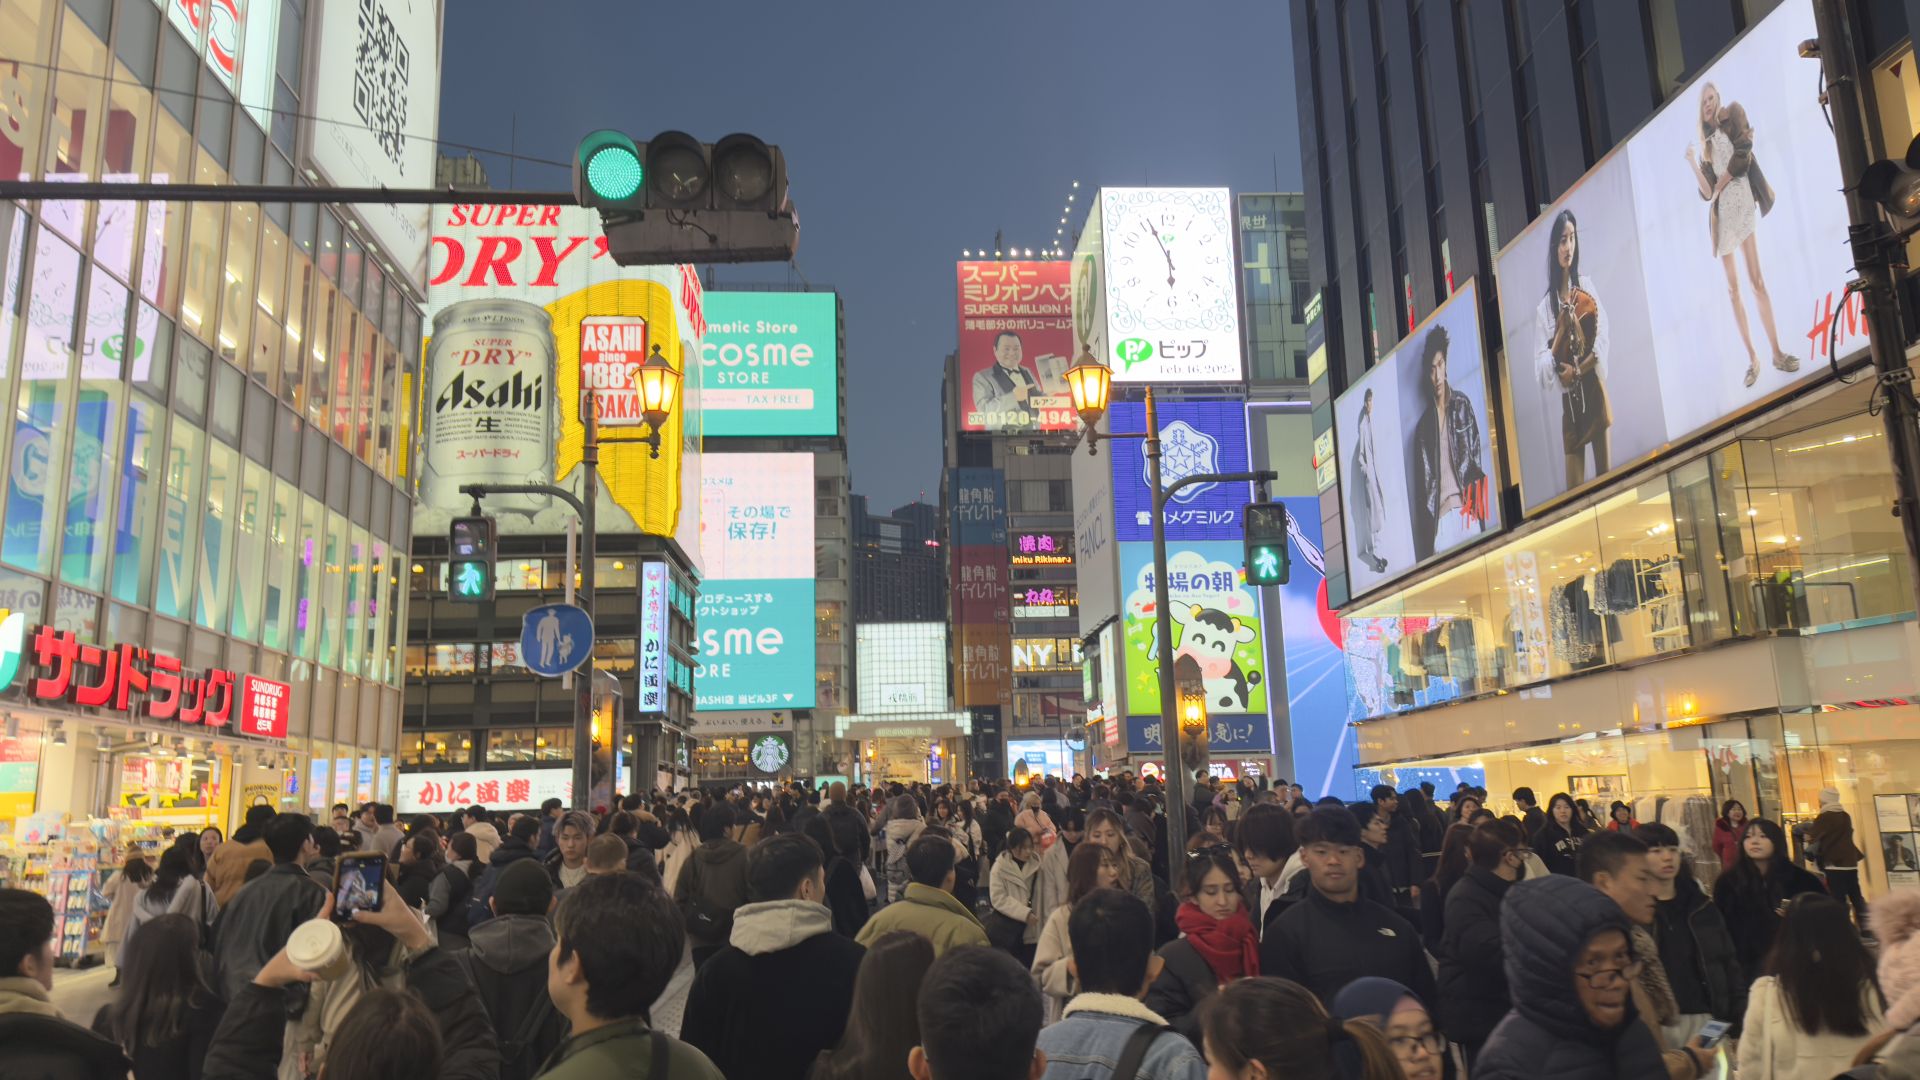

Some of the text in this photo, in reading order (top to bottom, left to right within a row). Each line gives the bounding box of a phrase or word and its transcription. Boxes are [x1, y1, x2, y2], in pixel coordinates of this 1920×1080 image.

[448, 204, 561, 226] SUPER
[963, 264, 1038, 283] スーパー
[964, 304, 1008, 315] SUPER
[1013, 304, 1061, 314] MILLION
[756, 320, 798, 334] Store
[473, 338, 513, 347] SUPER
[583, 325, 642, 352] ASAHI
[598, 352, 627, 363] since
[701, 343, 814, 367] cosme
[1158, 339, 1209, 359] ピップ
[717, 372, 770, 385] STORE
[436, 370, 543, 414] Asahi
[747, 395, 769, 404] TAX
[773, 395, 801, 404] FREE
[475, 416, 502, 433] 生
[456, 448, 520, 460] スーパードライ
[728, 506, 791, 519] その場で
[1079, 513, 1106, 568] FANCL
[35, 625, 236, 727] サンドラッグ
[251, 679, 283, 698] SUNDRUG
